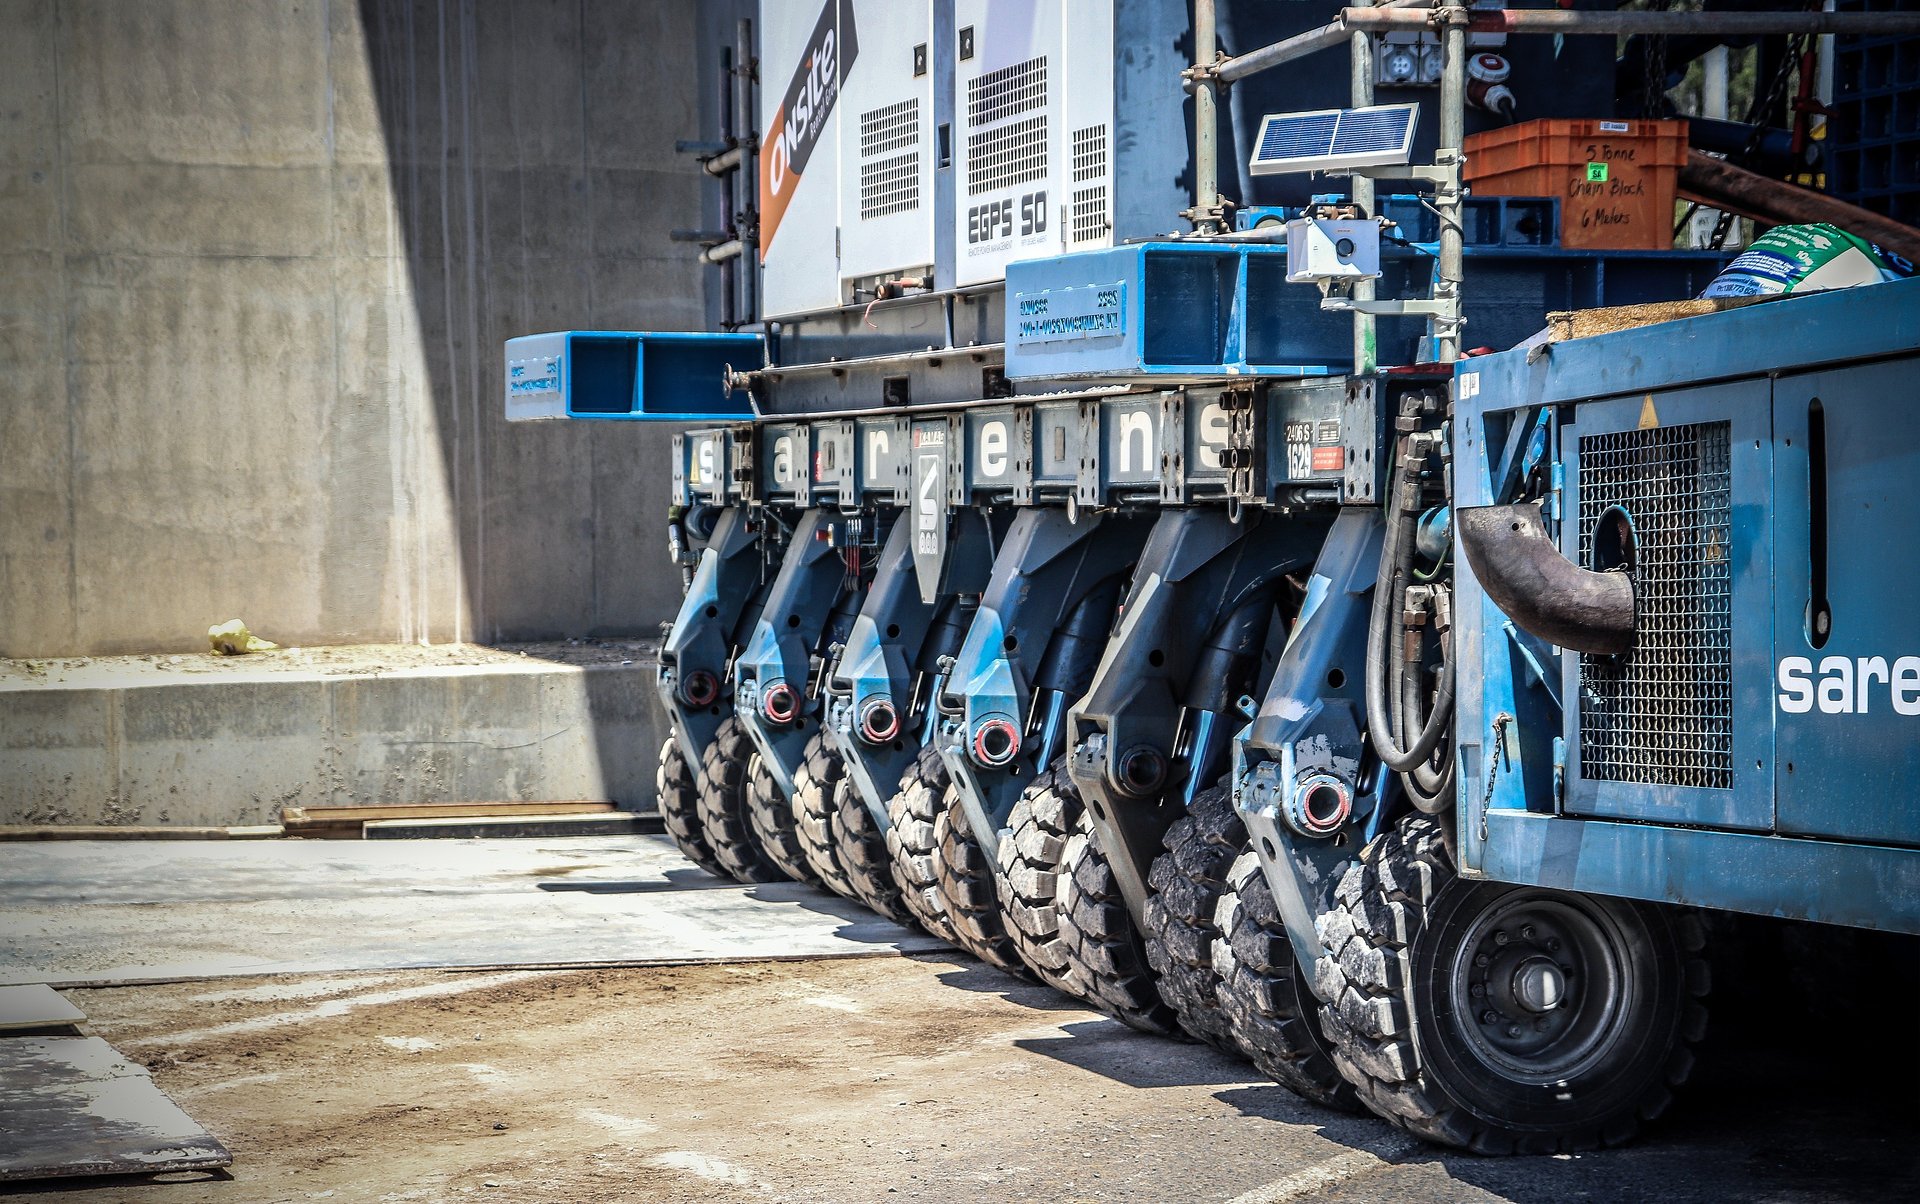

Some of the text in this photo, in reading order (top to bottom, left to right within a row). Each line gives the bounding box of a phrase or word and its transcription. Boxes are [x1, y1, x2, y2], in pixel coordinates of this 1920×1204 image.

[1586, 144, 1635, 161] 5 Tonne
[1610, 177, 1644, 197] Block
[968, 197, 1012, 244] EGPS
[1287, 443, 1311, 479] 1629
[1778, 655, 1920, 716] sare
